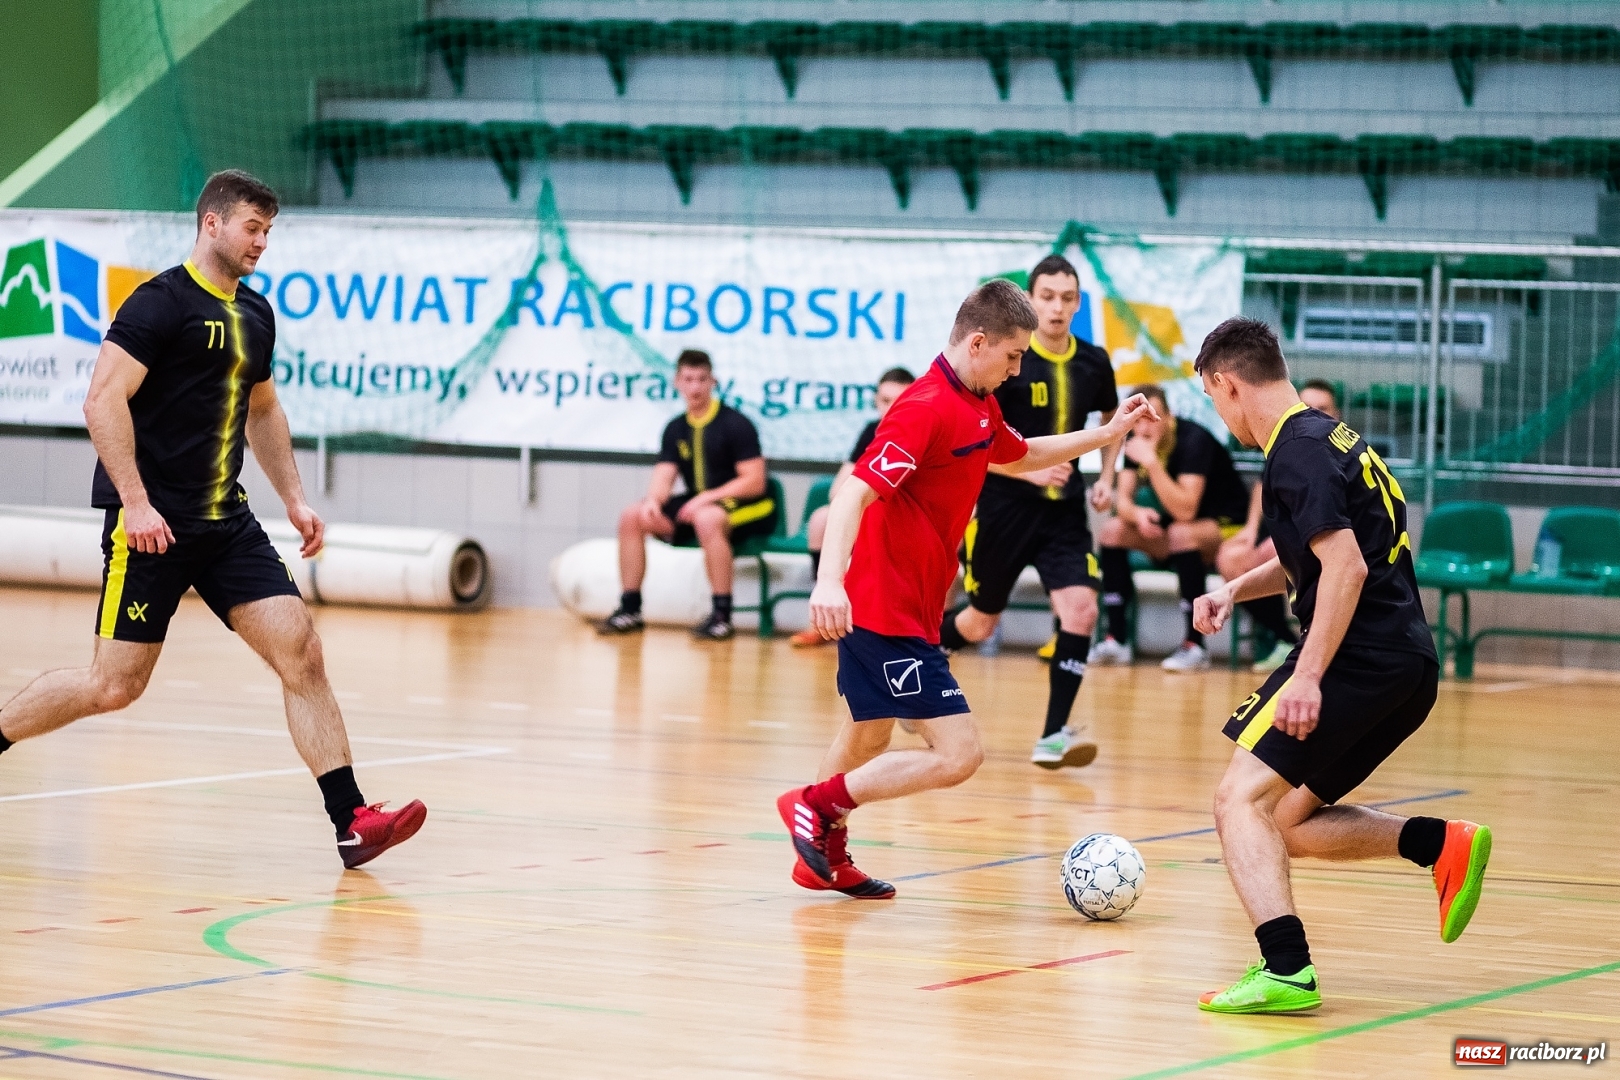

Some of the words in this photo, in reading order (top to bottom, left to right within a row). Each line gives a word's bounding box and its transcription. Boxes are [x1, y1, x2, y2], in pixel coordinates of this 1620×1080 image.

[511, 278, 905, 341] RACIBORSKI
[204, 320, 225, 349] 77
[1030, 381, 1048, 407] 10
